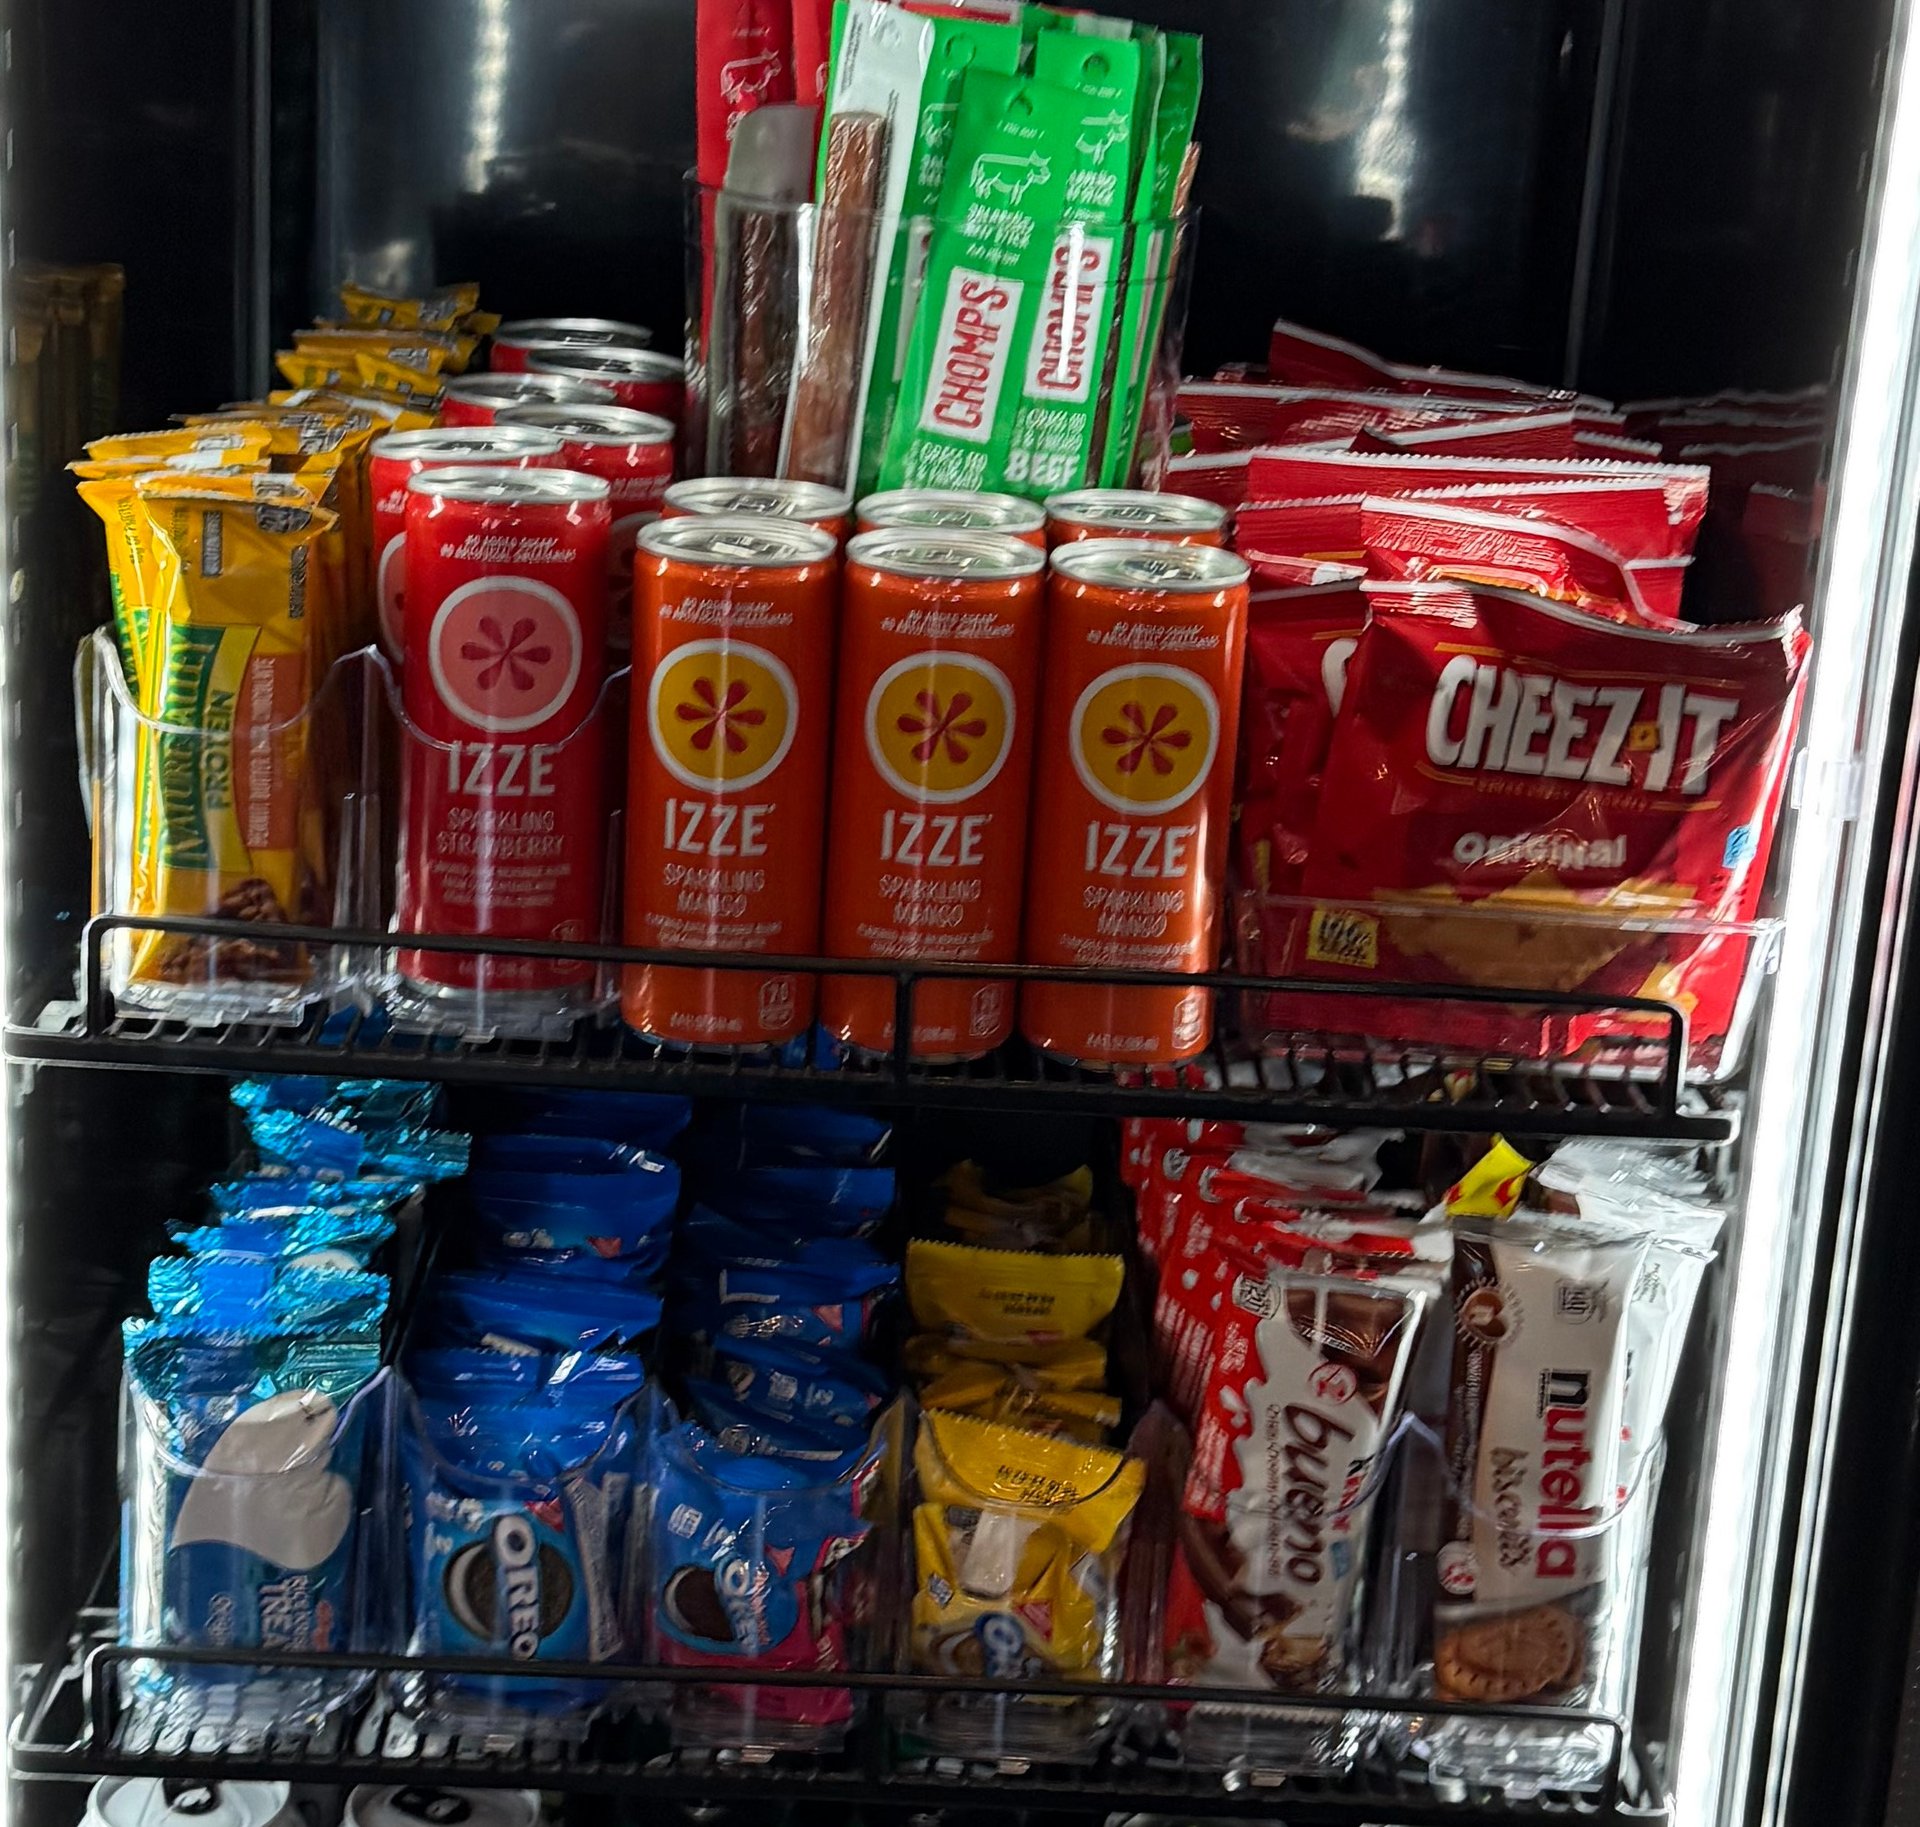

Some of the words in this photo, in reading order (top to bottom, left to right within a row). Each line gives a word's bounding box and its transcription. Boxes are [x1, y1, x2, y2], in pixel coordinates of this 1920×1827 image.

[932, 278, 1009, 429] CHOMPS
[1003, 448, 1081, 489] BEEF
[164, 630, 216, 743] VALLEY
[203, 689, 235, 810] PROTEIN
[447, 740, 558, 797] IZZE
[163, 745, 209, 867] NATURE
[448, 807, 555, 834] SPARKLING
[663, 798, 770, 858] IZZE
[436, 830, 564, 860] STRAWBERRY
[879, 809, 986, 868] IZZE
[1084, 820, 1190, 878] IZZE
[663, 862, 766, 893] SPARKLING
[879, 873, 982, 904] SPARKLING
[1083, 885, 1185, 914] SPARKLING
[1283, 1402, 1356, 1586] bueno
[1533, 1369, 1604, 1579] nutella
[495, 1514, 540, 1661] OREO
[259, 1580, 293, 1662] TREA
